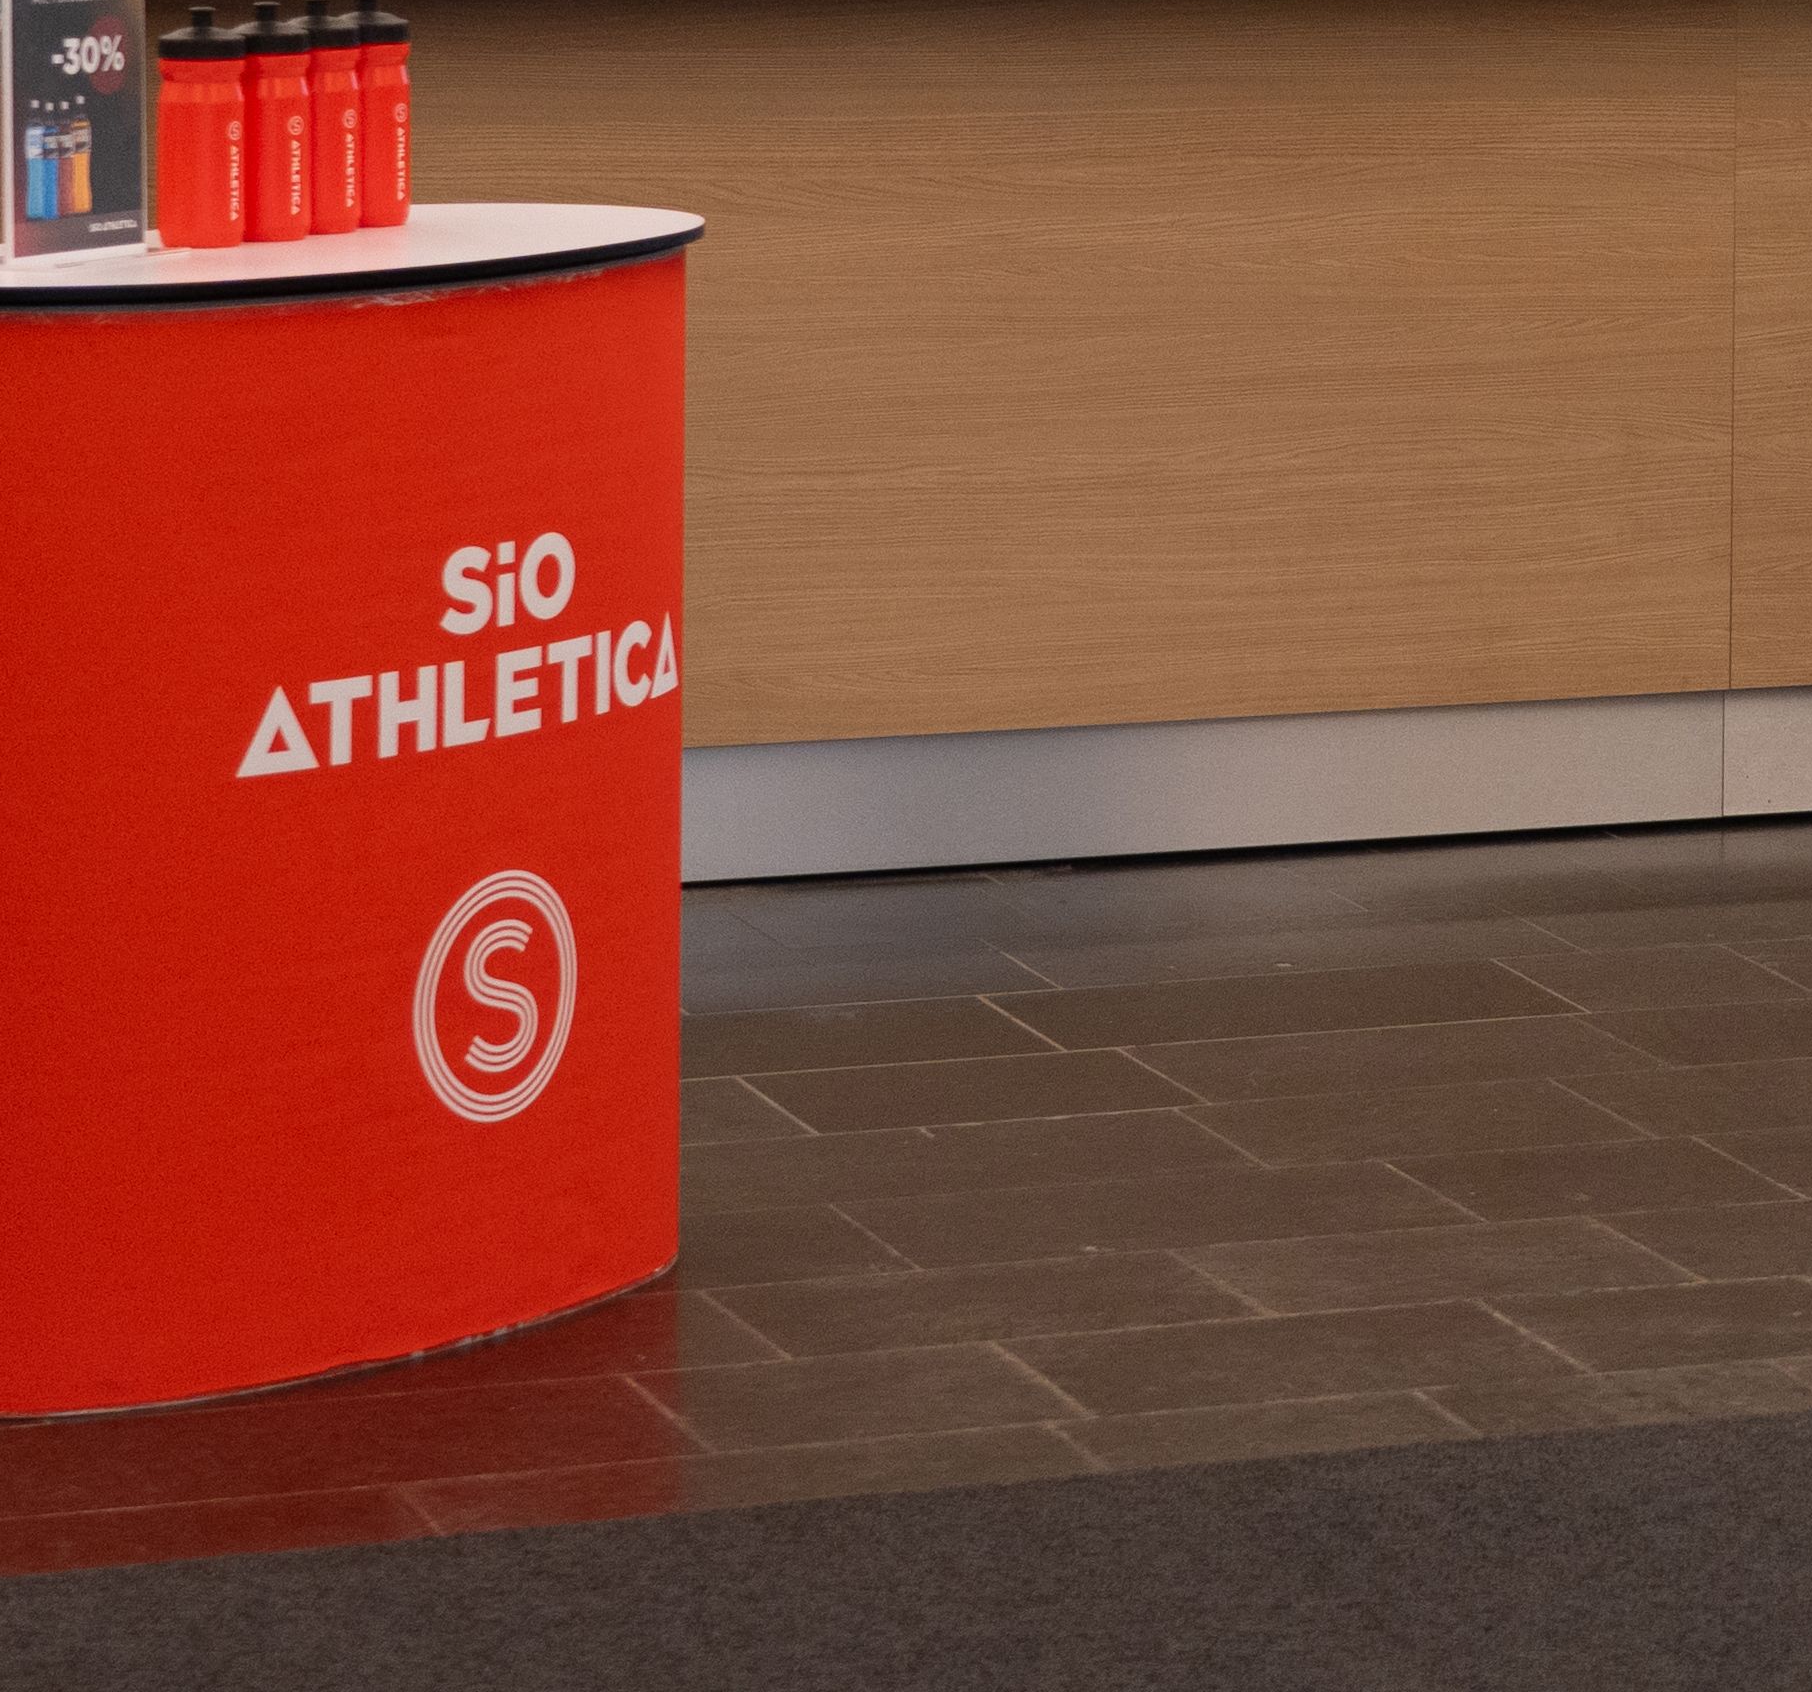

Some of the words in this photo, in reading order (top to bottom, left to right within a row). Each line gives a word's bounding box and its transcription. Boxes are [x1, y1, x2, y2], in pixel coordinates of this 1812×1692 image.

[52, 35, 125, 75] -30%
[229, 145, 240, 222] ATHLETICA
[291, 139, 301, 216] ATHLETICA
[344, 133, 355, 208] ATHLETICA
[396, 126, 406, 202] ATHLETICA
[439, 531, 577, 635] SiO
[235, 610, 680, 779] ATHLETICA
